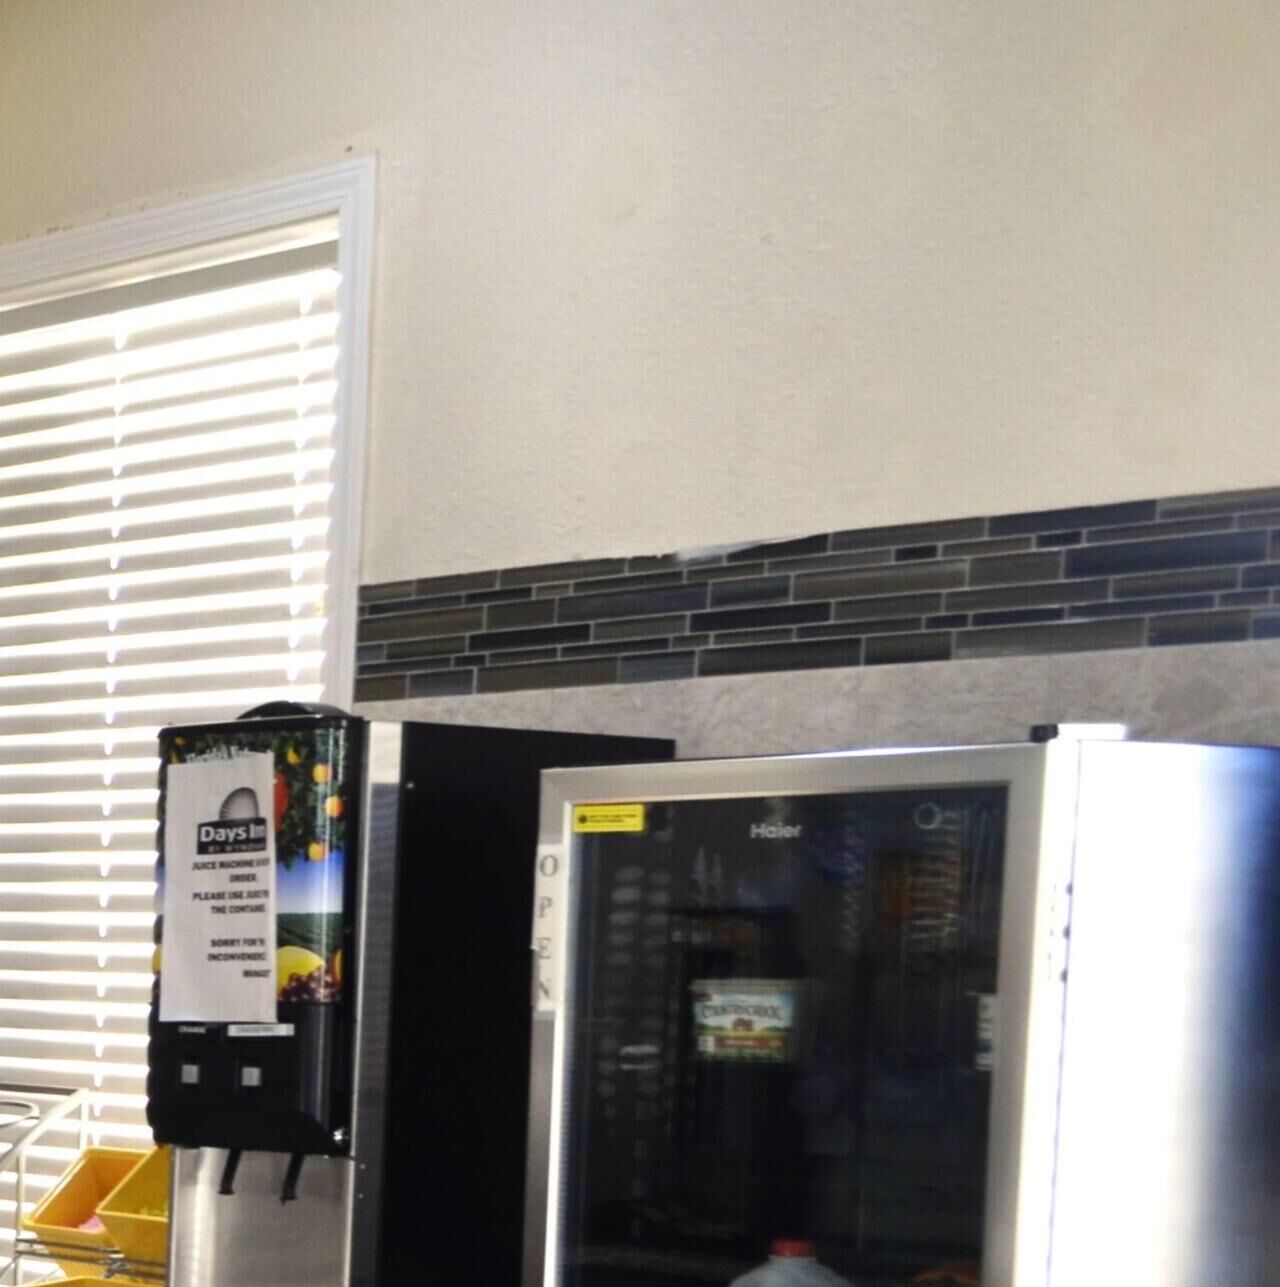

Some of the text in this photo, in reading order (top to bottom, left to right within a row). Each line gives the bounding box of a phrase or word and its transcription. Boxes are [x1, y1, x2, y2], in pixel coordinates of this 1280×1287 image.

[200, 825, 248, 843] Days
[750, 822, 802, 839] Haier
[192, 860, 217, 870] JUICE
[218, 858, 254, 869] MACHINE
[192, 890, 226, 901] PLEASE
[211, 904, 227, 914] THE
[210, 938, 241, 948] SORRY
